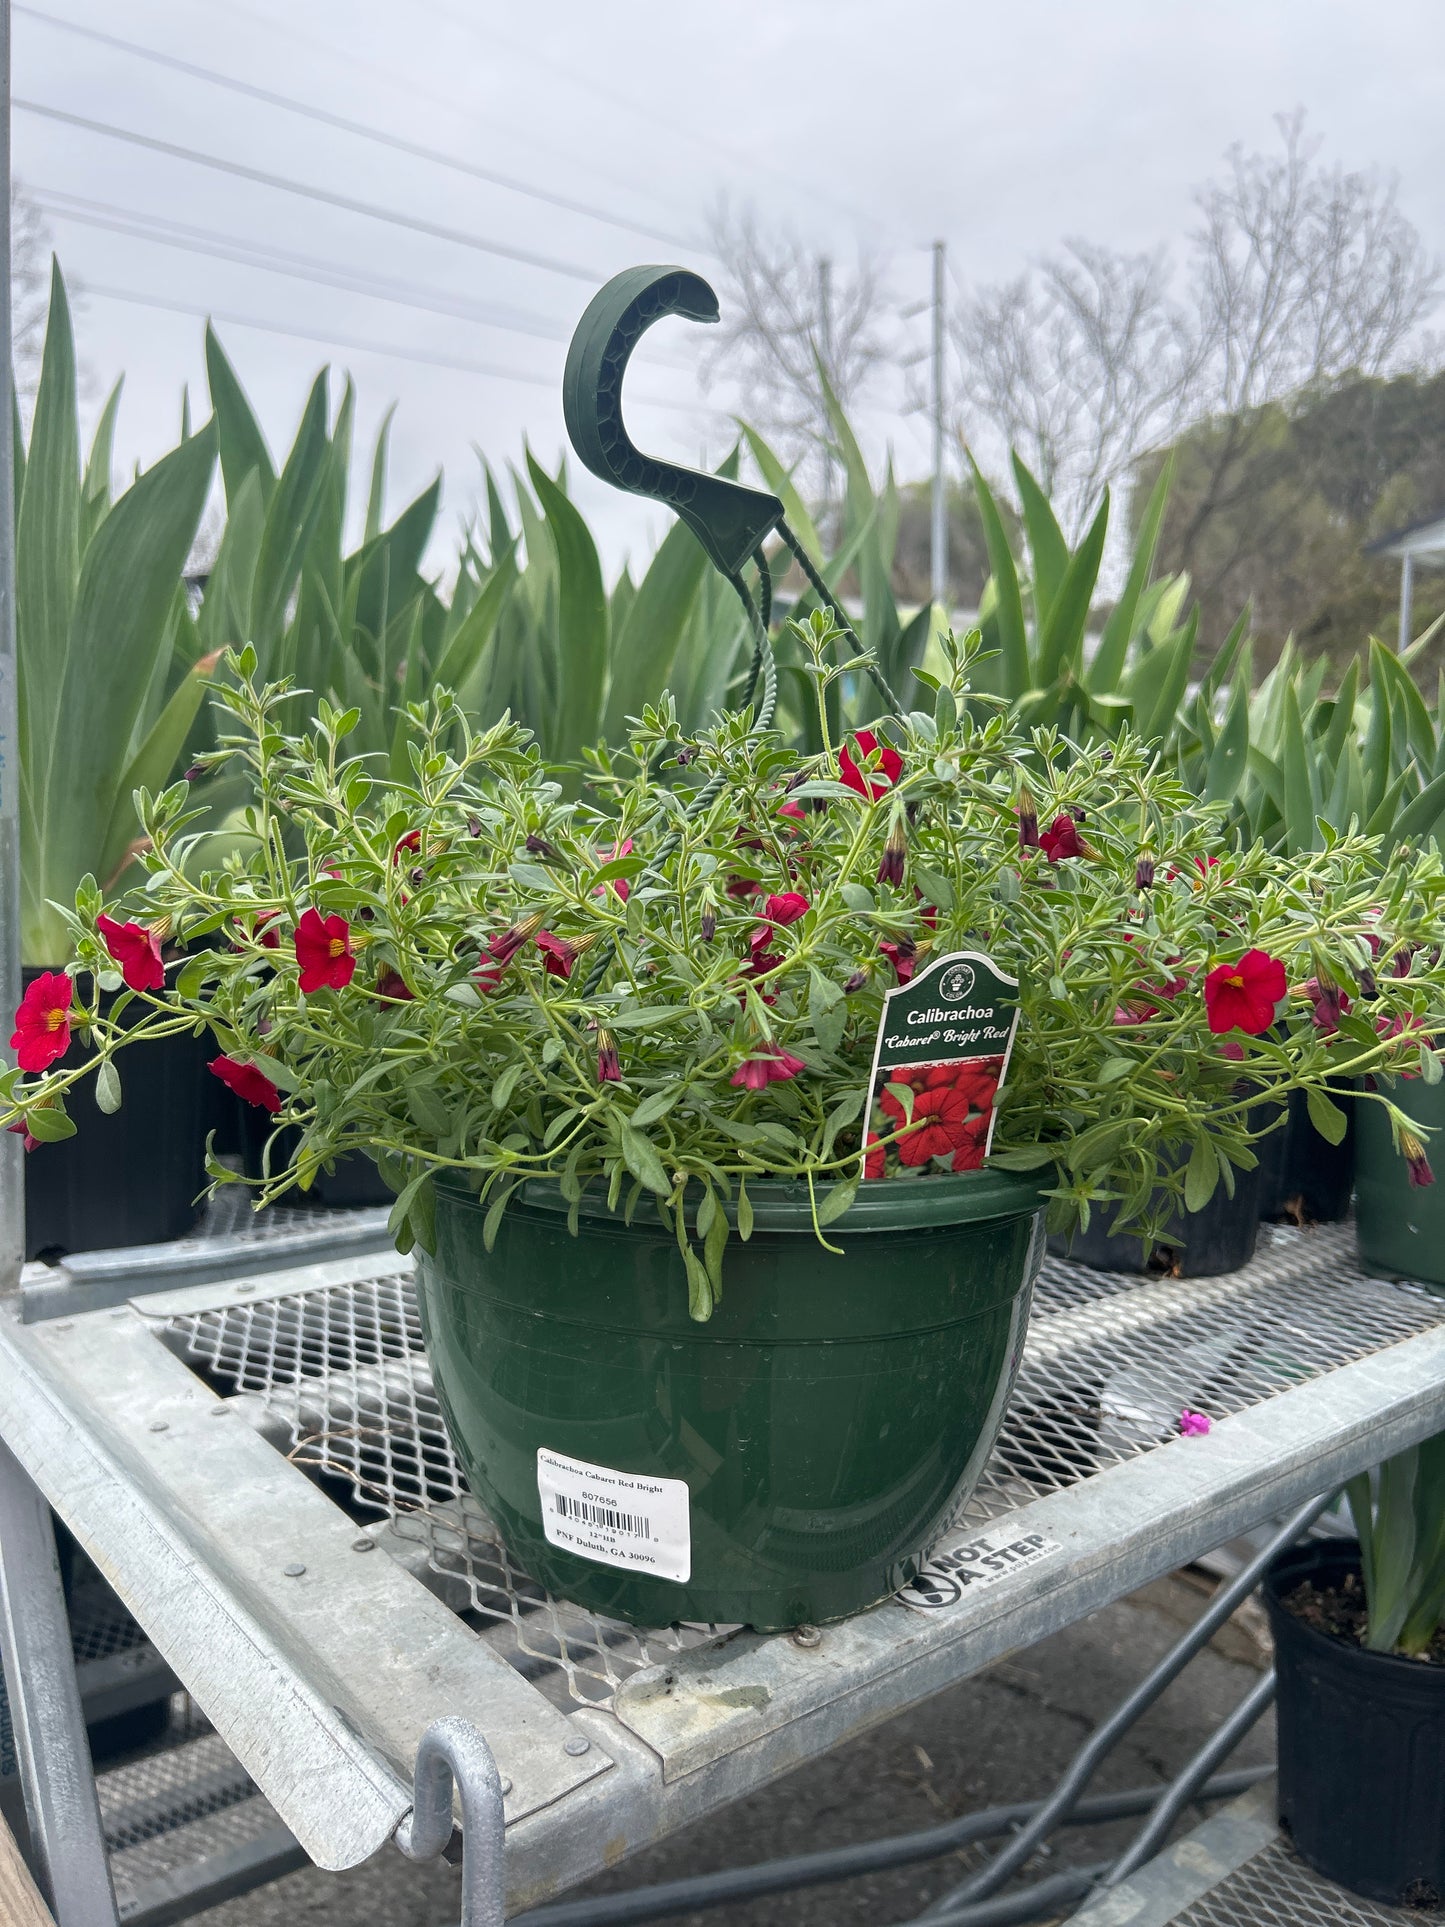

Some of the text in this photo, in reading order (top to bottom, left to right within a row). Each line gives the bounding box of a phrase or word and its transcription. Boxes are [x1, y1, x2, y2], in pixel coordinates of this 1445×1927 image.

[907, 1005, 994, 1025] Calibrachoa
[943, 1028, 981, 1047] Bright
[983, 1025, 1010, 1039] Red
[540, 1454, 663, 1494] Calibrachoa Cabaret Red Bright
[582, 1491, 618, 1507] 807656
[556, 1529, 656, 1563] PNF Duluth, GA 30096
[930, 1538, 996, 1574] NOT
[955, 1534, 1045, 1586] A STEP
